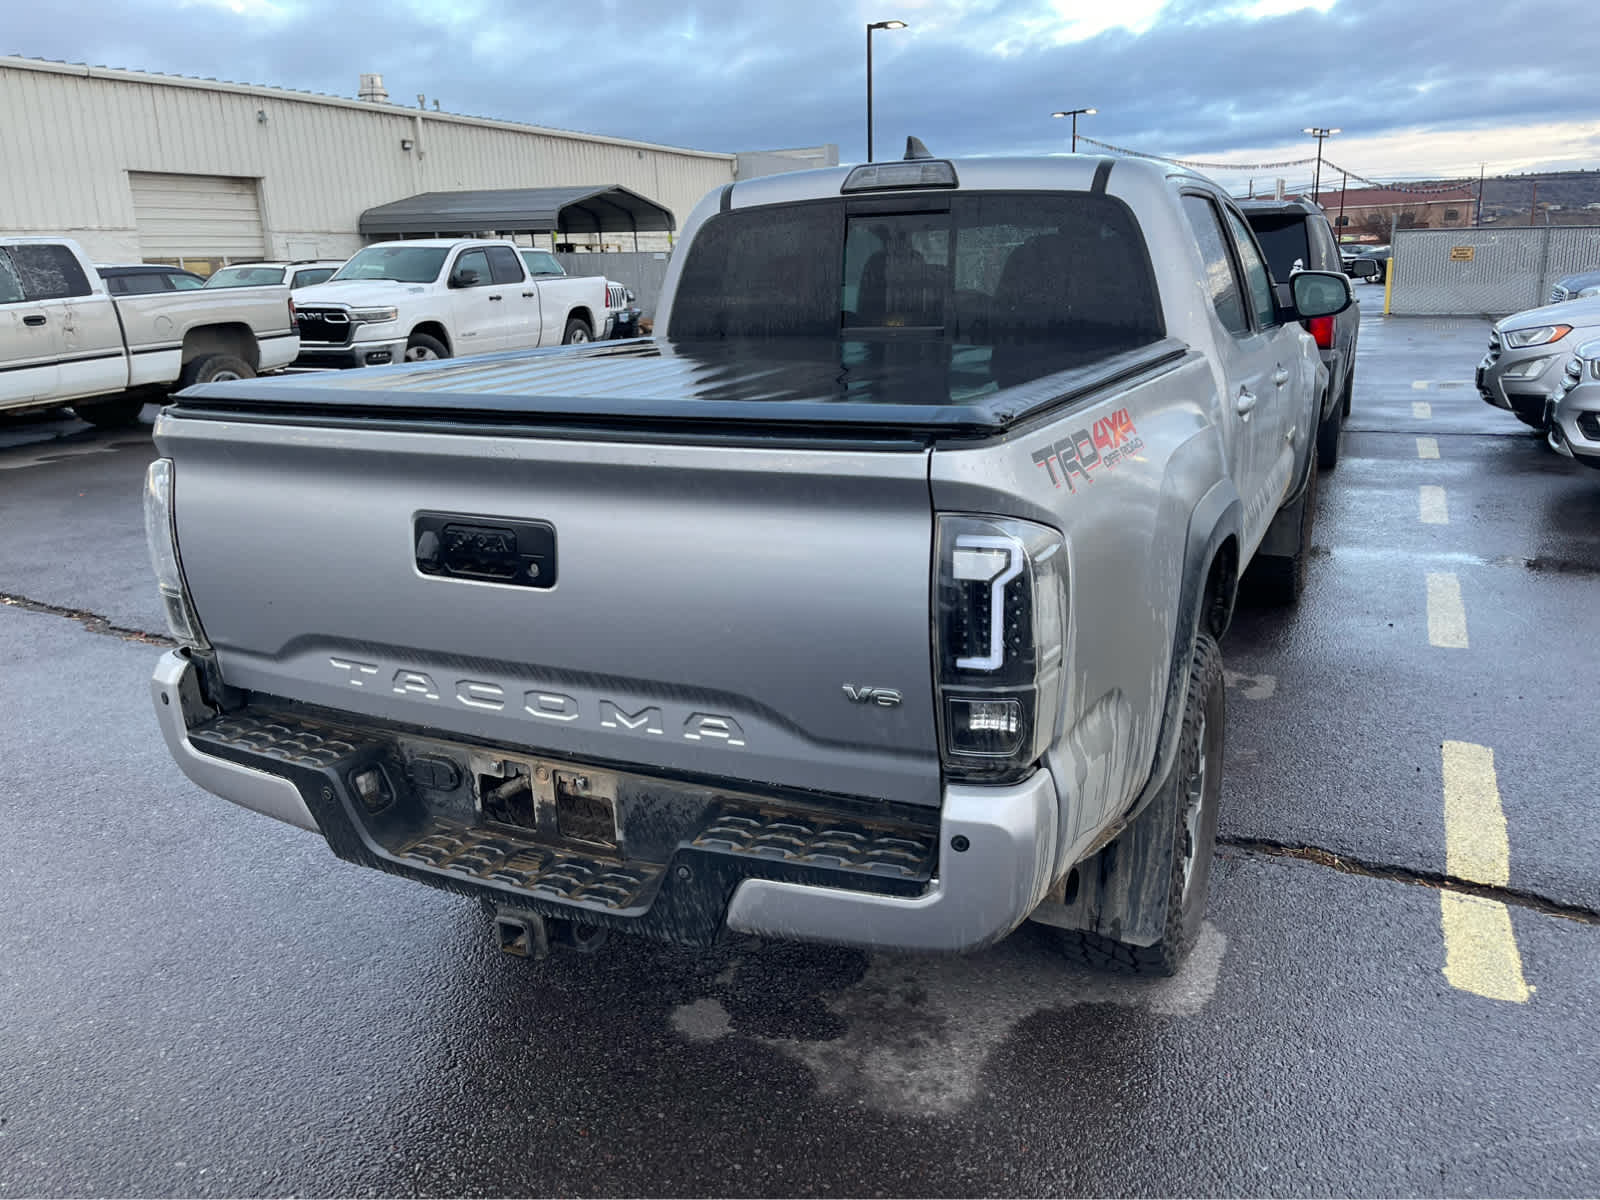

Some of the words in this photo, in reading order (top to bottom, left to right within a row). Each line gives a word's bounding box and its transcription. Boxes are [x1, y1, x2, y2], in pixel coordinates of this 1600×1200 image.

[295, 312, 322, 321] AM
[1120, 437, 1145, 458] ROAD
[1032, 429, 1101, 494] TRD
[329, 657, 745, 745] TACOMA
[842, 683, 903, 707] V6
